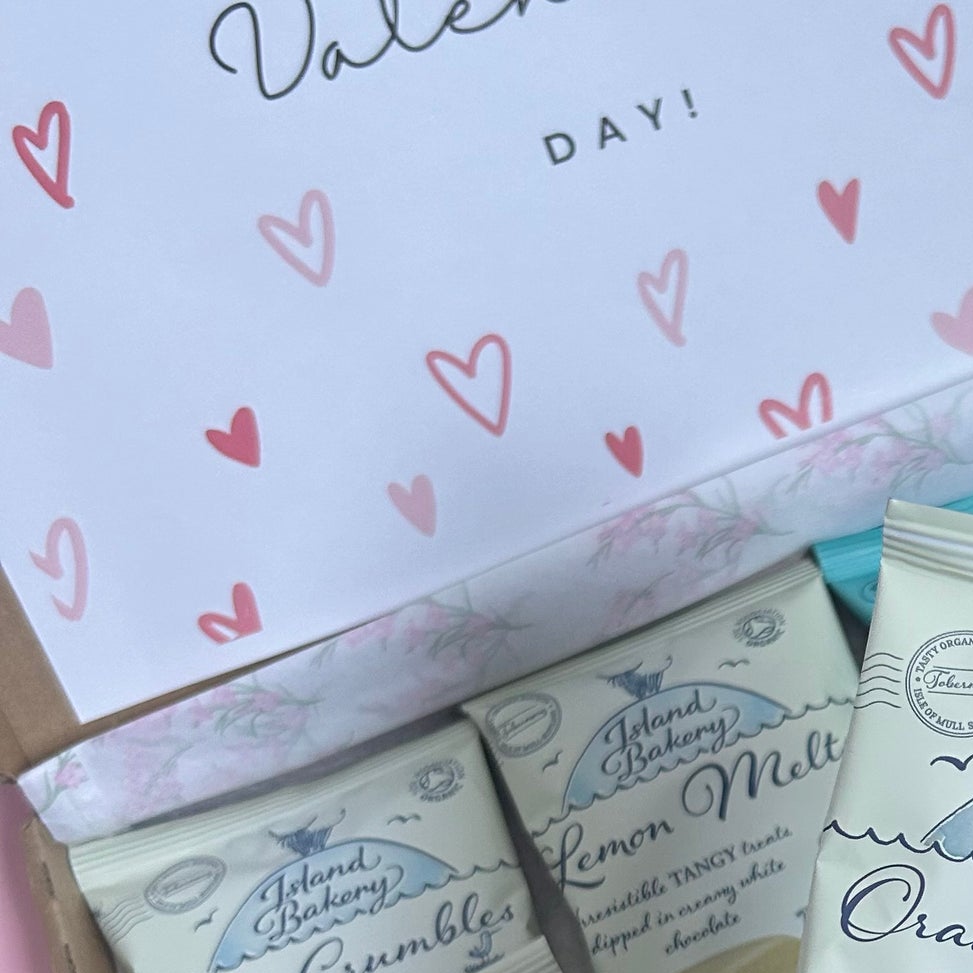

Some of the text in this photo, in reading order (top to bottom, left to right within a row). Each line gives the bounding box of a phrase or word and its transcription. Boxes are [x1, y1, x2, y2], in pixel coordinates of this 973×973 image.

[543, 89, 699, 165] DAY!
[915, 645, 940, 674] TASTY
[601, 704, 741, 779] Bakery
[604, 689, 718, 751] Island
[914, 687, 929, 710] ISLE
[924, 707, 939, 720] OF
[936, 715, 966, 732] MULL
[540, 729, 842, 895] Lemon Melt
[259, 845, 384, 906] Island
[668, 846, 738, 889] TANGY
[741, 825, 794, 858] treats
[253, 864, 404, 940] Bakery
[591, 858, 786, 957] dipped in creamy white
[664, 912, 743, 957] chocolate
